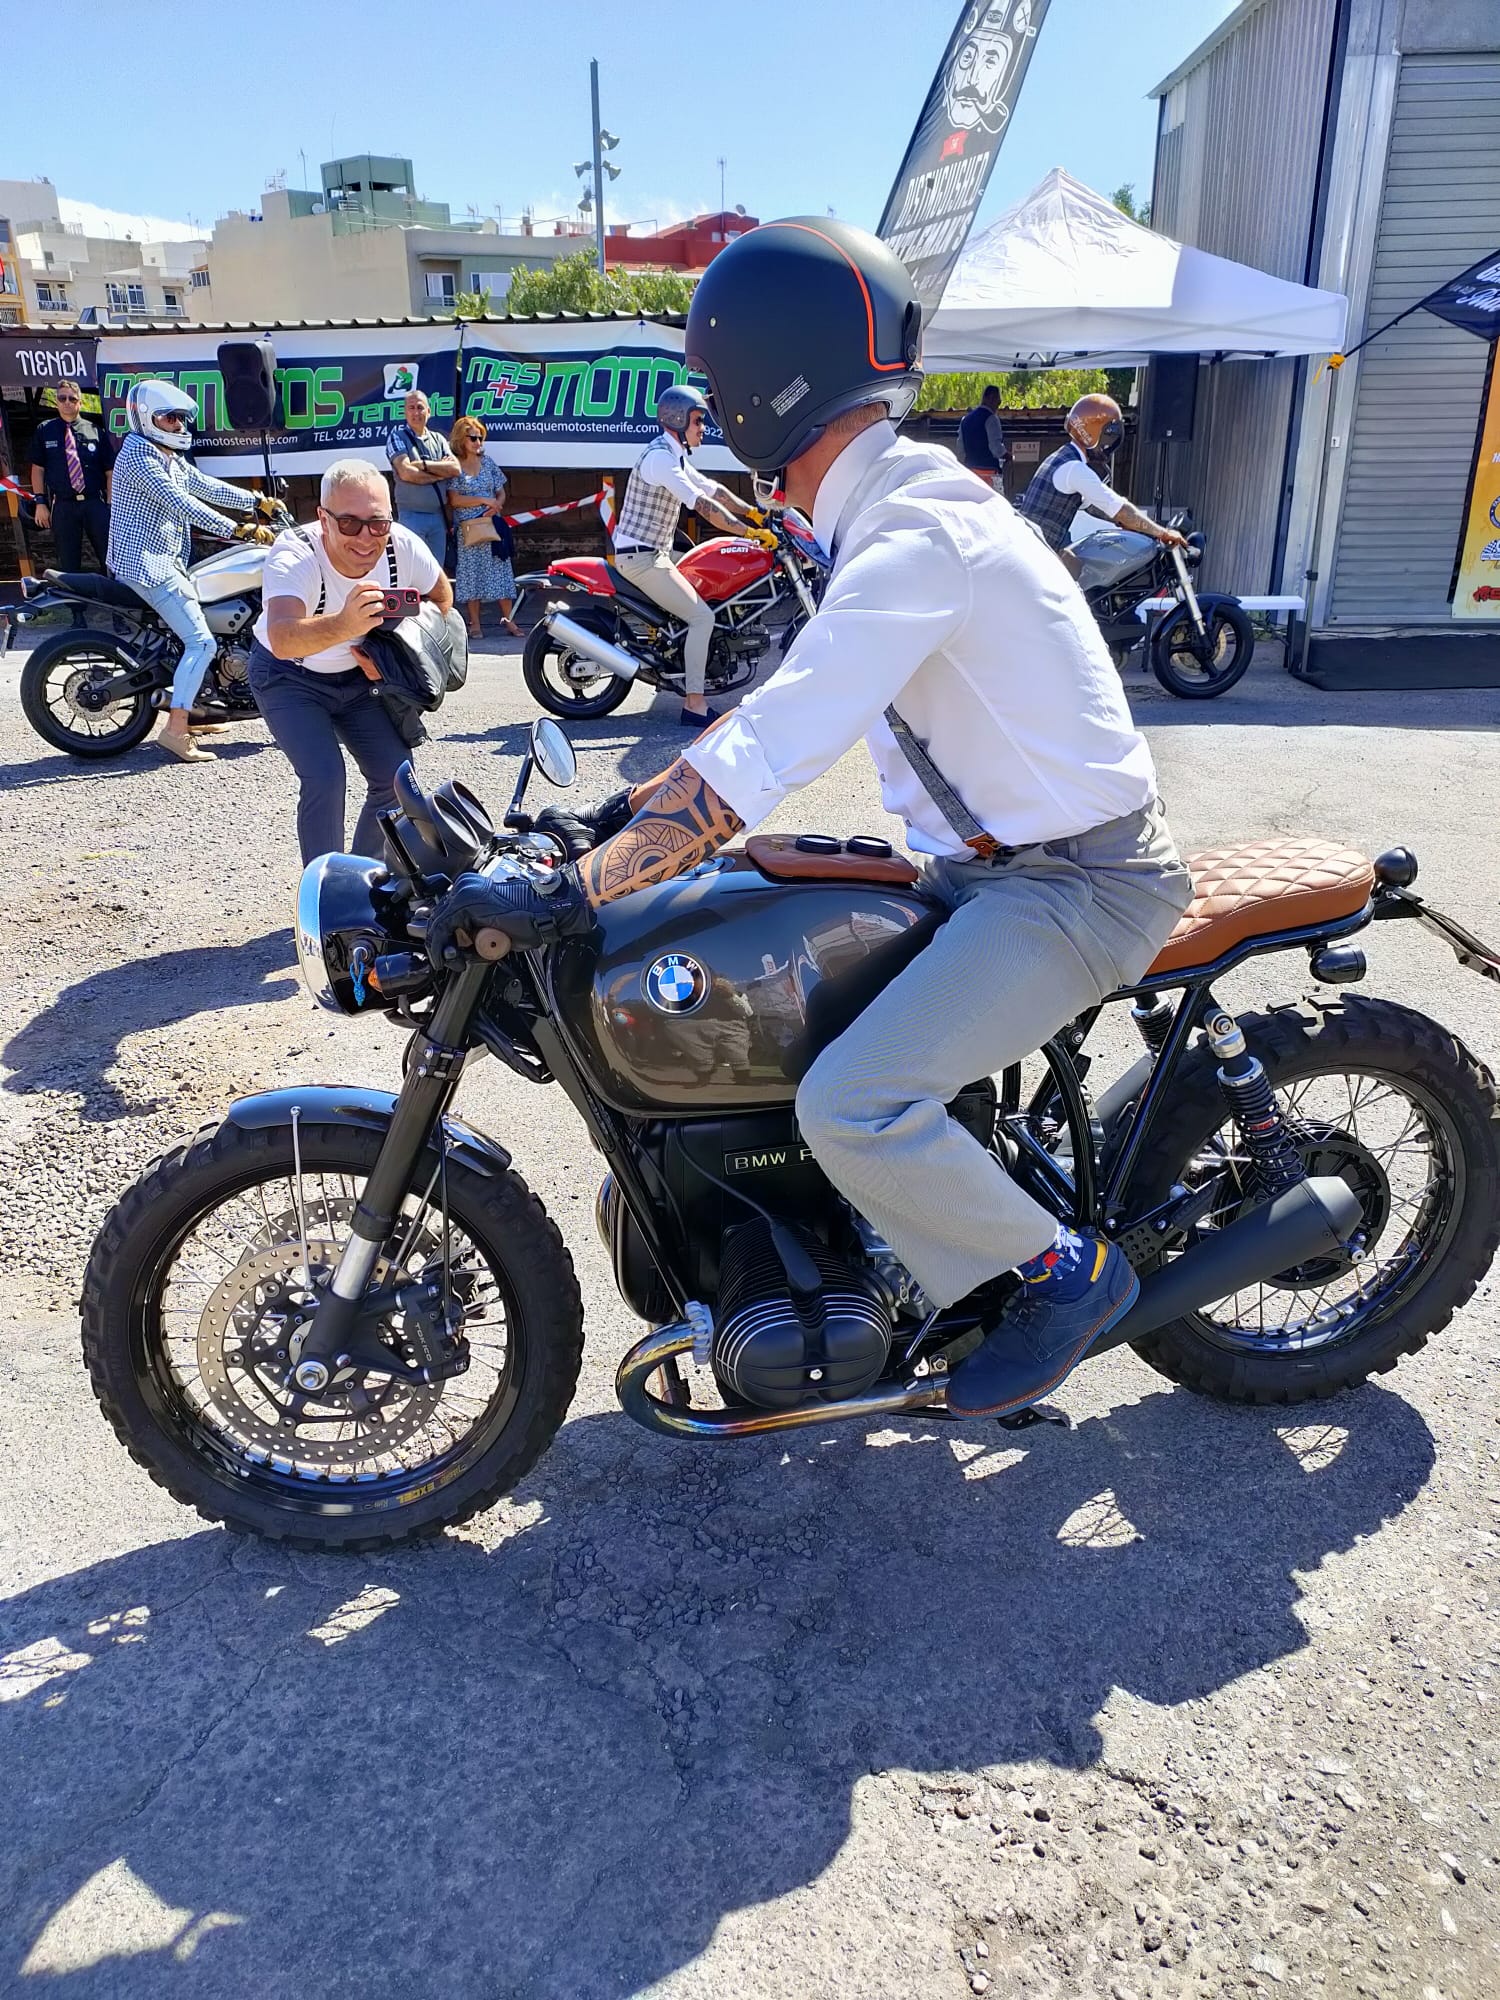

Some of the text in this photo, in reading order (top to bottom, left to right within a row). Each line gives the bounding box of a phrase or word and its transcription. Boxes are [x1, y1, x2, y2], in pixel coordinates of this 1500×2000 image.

[893, 151, 990, 230] DISTINGUISHED
[882, 210, 974, 264] ENTLEMAN'S
[15, 350, 88, 377] TIENDA
[178, 366, 346, 432] MOS
[314, 431, 334, 443] TEL.
[336, 429, 355, 440] 922
[358, 427, 372, 439] 38
[376, 426, 388, 438] 74
[485, 421, 660, 434] www.masquemotostenerife.com
[703, 425, 725, 440] 922
[720, 546, 749, 555] DUCATI
[652, 956, 698, 977] BMW
[734, 1151, 786, 1170] BMW
[415, 1321, 432, 1362] TOKICO
[395, 1481, 435, 1504] EXCEL
